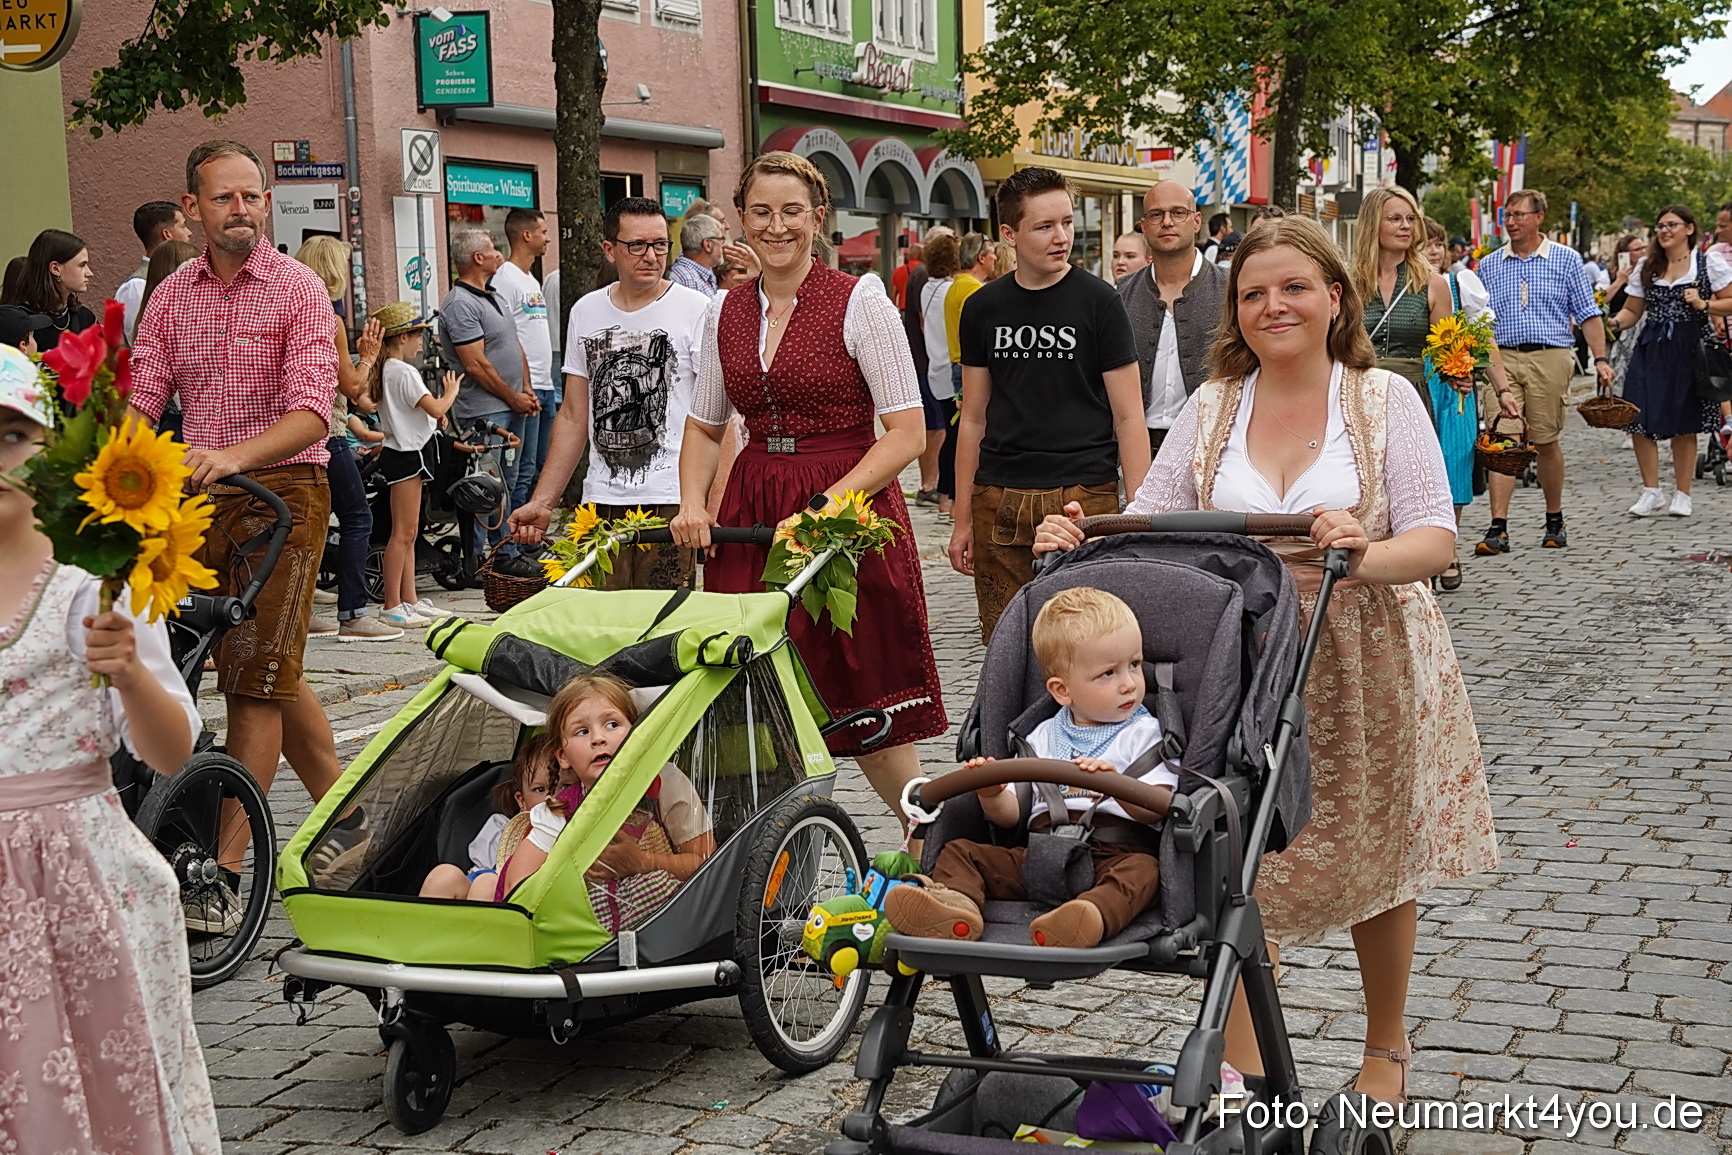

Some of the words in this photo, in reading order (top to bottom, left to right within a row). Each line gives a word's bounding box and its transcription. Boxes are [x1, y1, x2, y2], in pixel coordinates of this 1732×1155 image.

[0, 13, 57, 31] ARKT
[428, 29, 455, 48] vom
[438, 34, 478, 62] FASS
[435, 78, 476, 86] PROBIEREN
[277, 165, 342, 178] Bockwirtsgasse
[413, 179, 433, 190] ZONE
[447, 174, 494, 196] Spirituosen
[500, 179, 532, 202] Whisky
[280, 204, 310, 215] Venezia
[994, 325, 1077, 350] BOSS
[994, 351, 1030, 359] HUGO
[1037, 351, 1074, 360] BOSS
[176, 596, 193, 607] ULE
